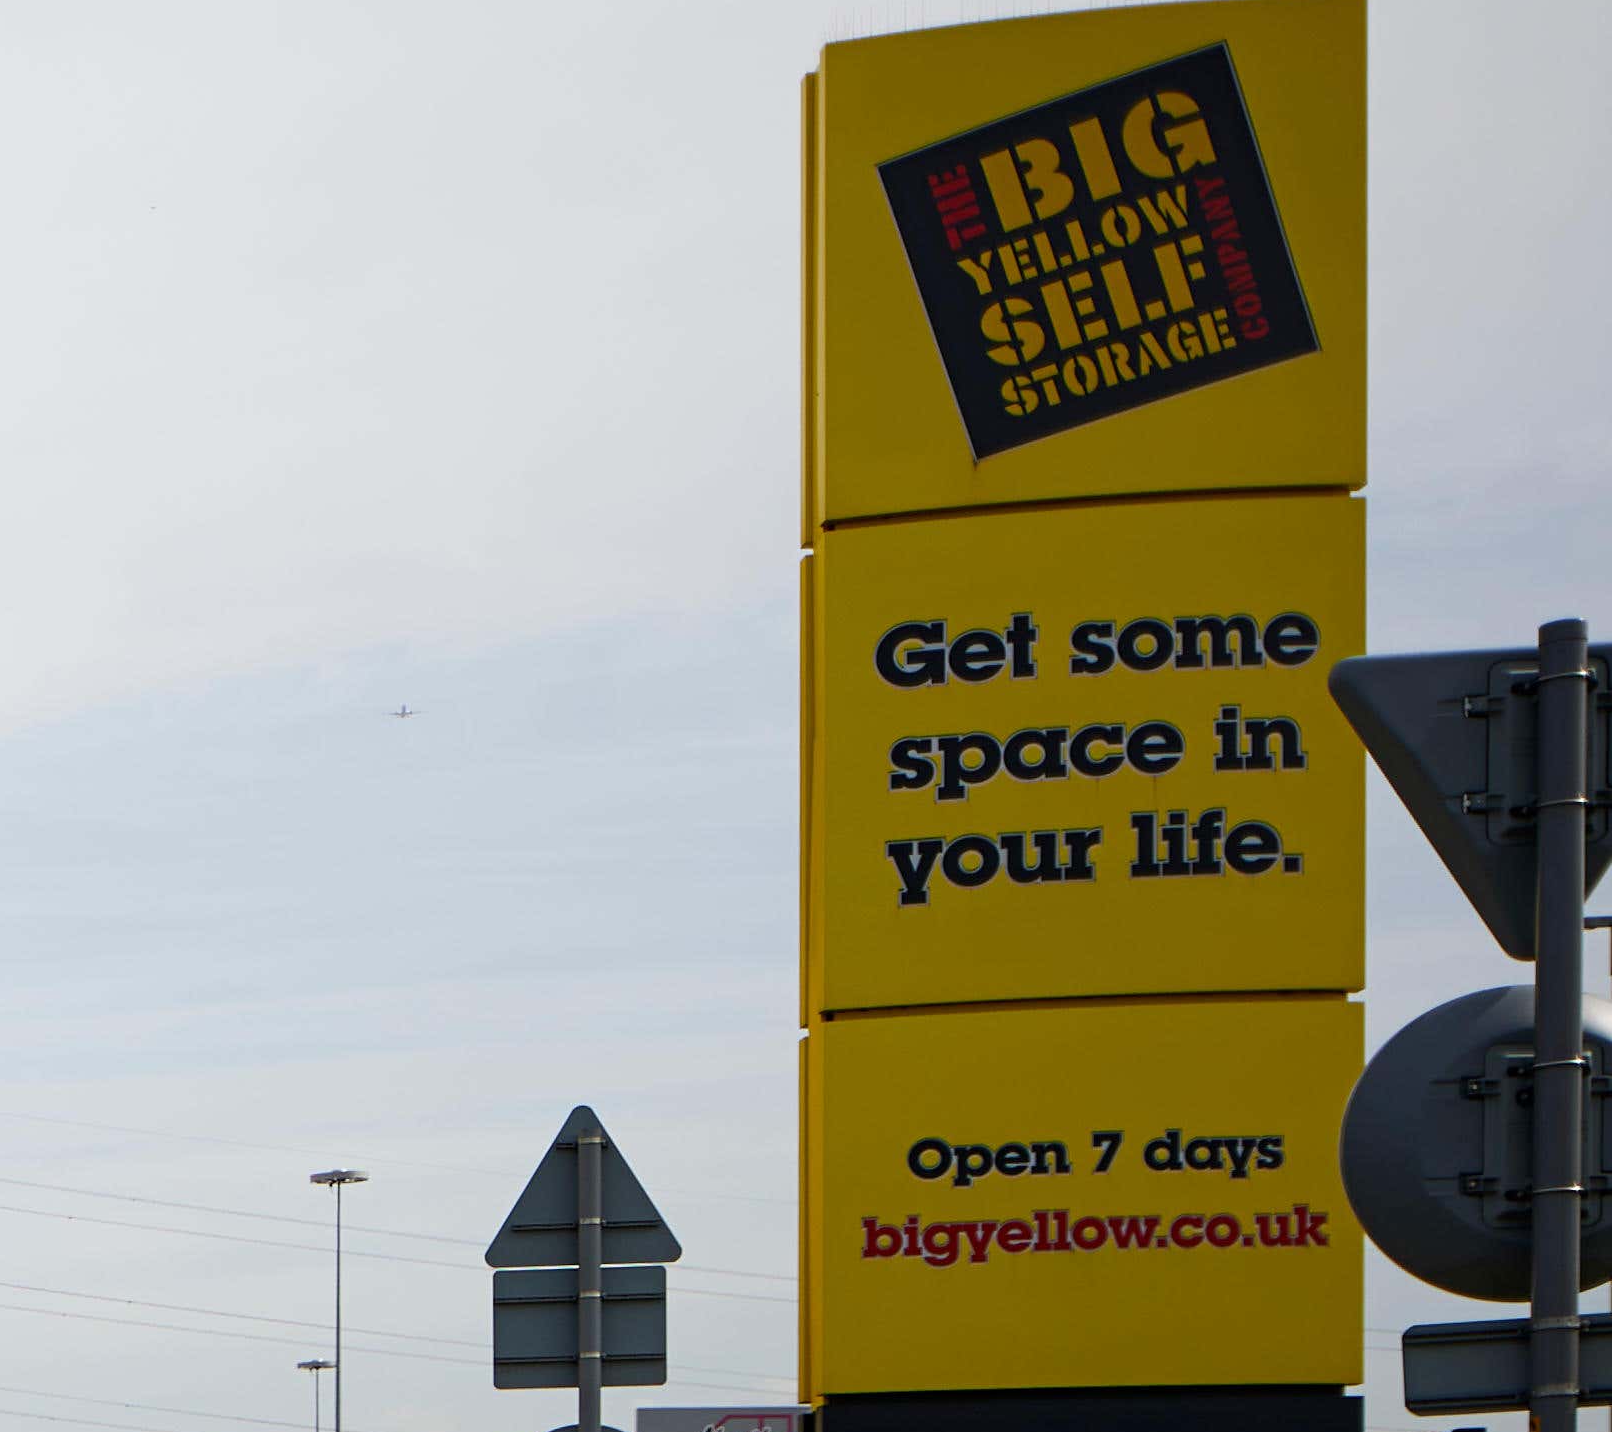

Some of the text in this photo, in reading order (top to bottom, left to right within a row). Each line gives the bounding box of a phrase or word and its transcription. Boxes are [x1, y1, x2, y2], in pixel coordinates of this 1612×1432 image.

[928, 164, 987, 253] THE
[979, 90, 1217, 233] BIG
[957, 185, 1188, 296] YELLOW
[1193, 173, 1269, 342] COMPANY
[980, 234, 1206, 367] SELF
[1000, 308, 1237, 418] STORAGE
[874, 611, 1320, 690] Get some
[888, 703, 1310, 804] space in
[886, 807, 1303, 908] your life.
[906, 1128, 1286, 1188] Open 7 days
[862, 1204, 1330, 1268] bigyellow.co.uk
